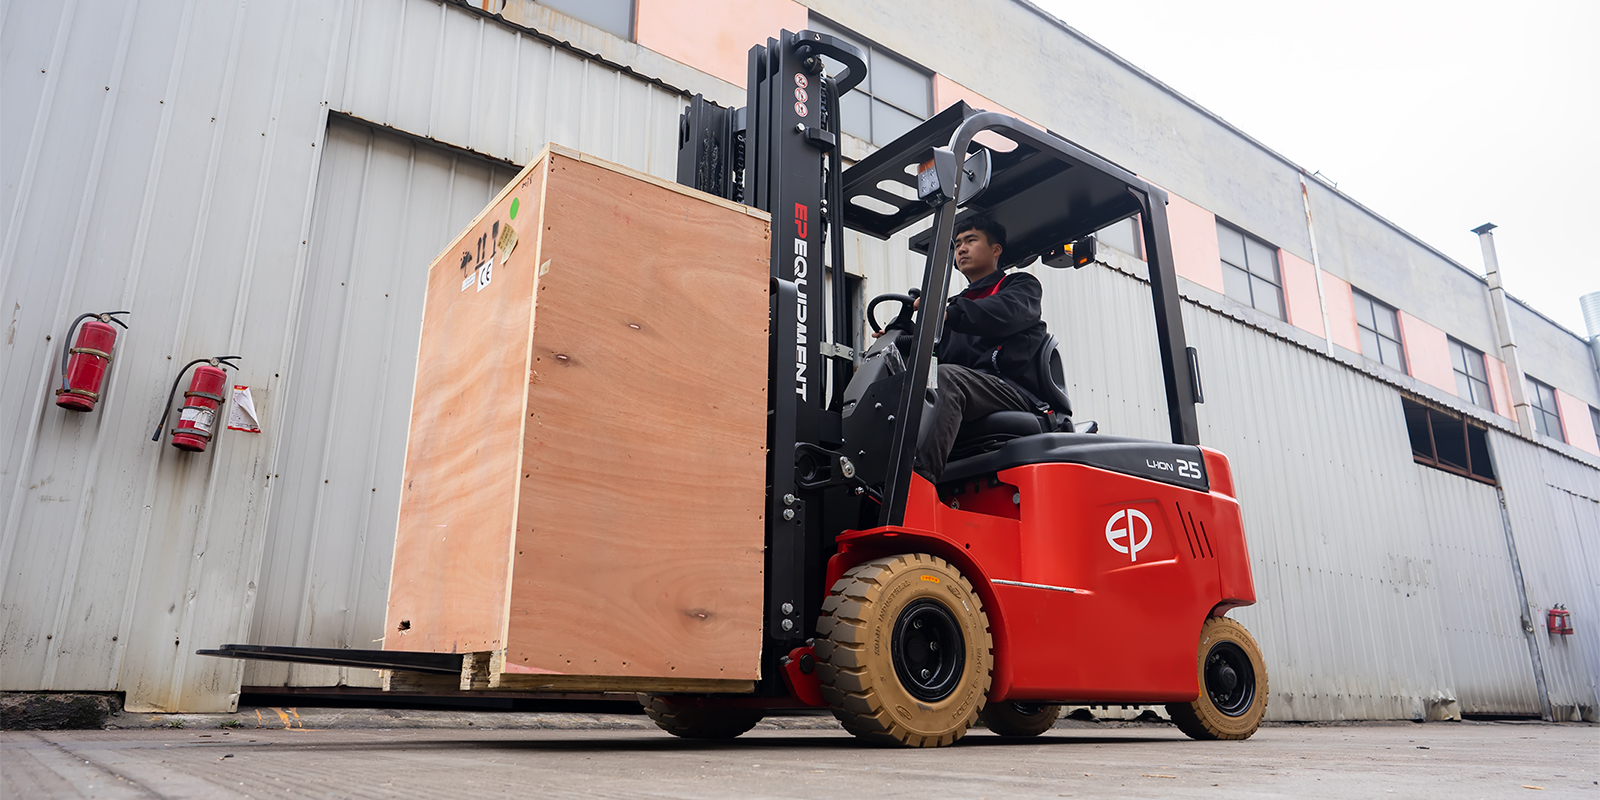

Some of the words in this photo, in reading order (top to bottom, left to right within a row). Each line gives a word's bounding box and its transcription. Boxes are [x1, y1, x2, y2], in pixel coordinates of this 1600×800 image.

[480, 263, 491, 285] CE
[794, 238, 808, 402] EQUIPMENT
[1176, 459, 1201, 479] 25
[1105, 508, 1152, 562] EP
